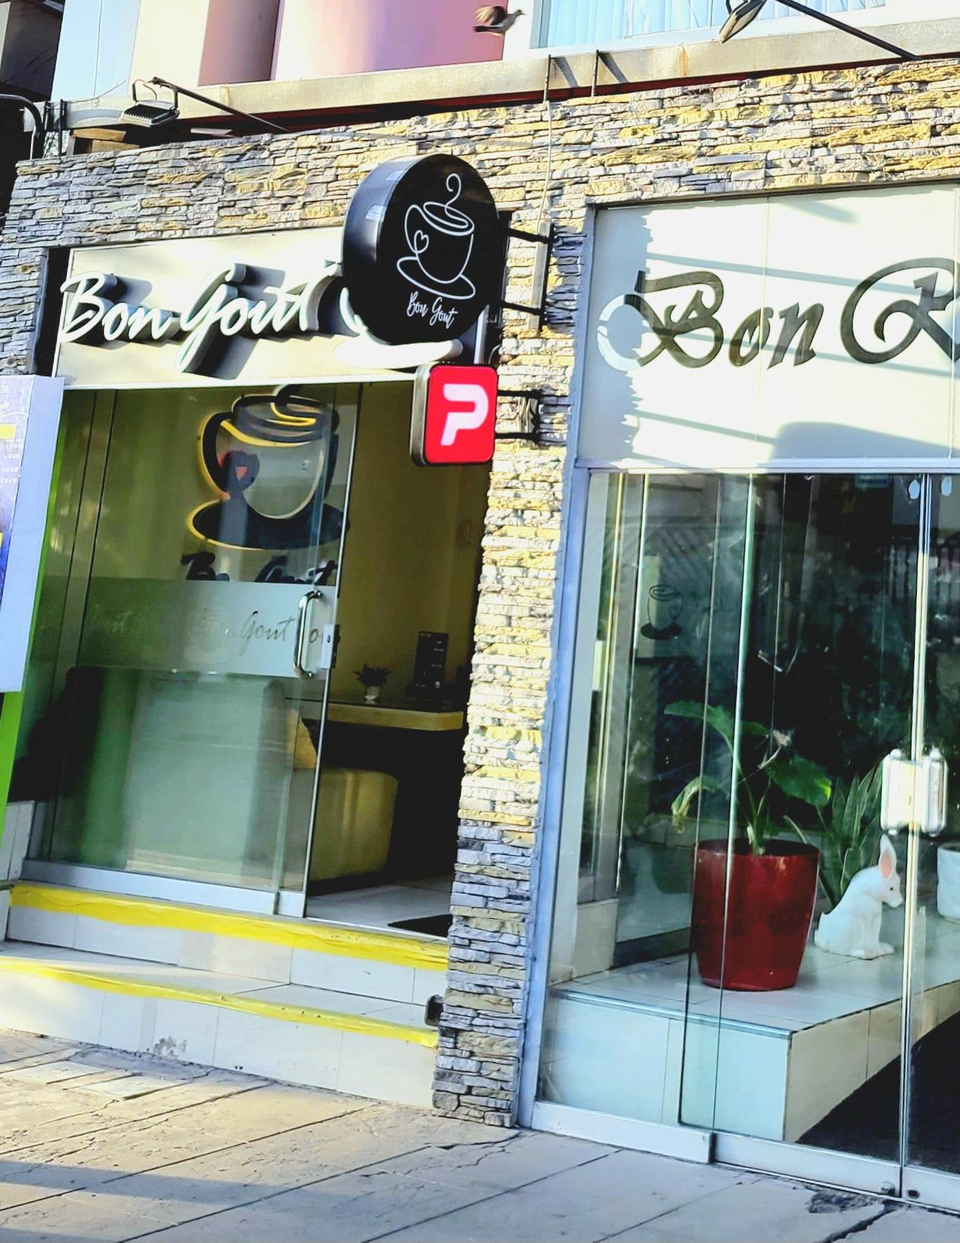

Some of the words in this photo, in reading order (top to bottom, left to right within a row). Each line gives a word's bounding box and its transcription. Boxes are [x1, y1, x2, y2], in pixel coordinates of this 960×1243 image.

[60, 271, 173, 343] Bon
[174, 261, 342, 373] Gout
[406, 291, 428, 317] Bon
[429, 296, 459, 329] Gout
[597, 270, 825, 372] Bon
